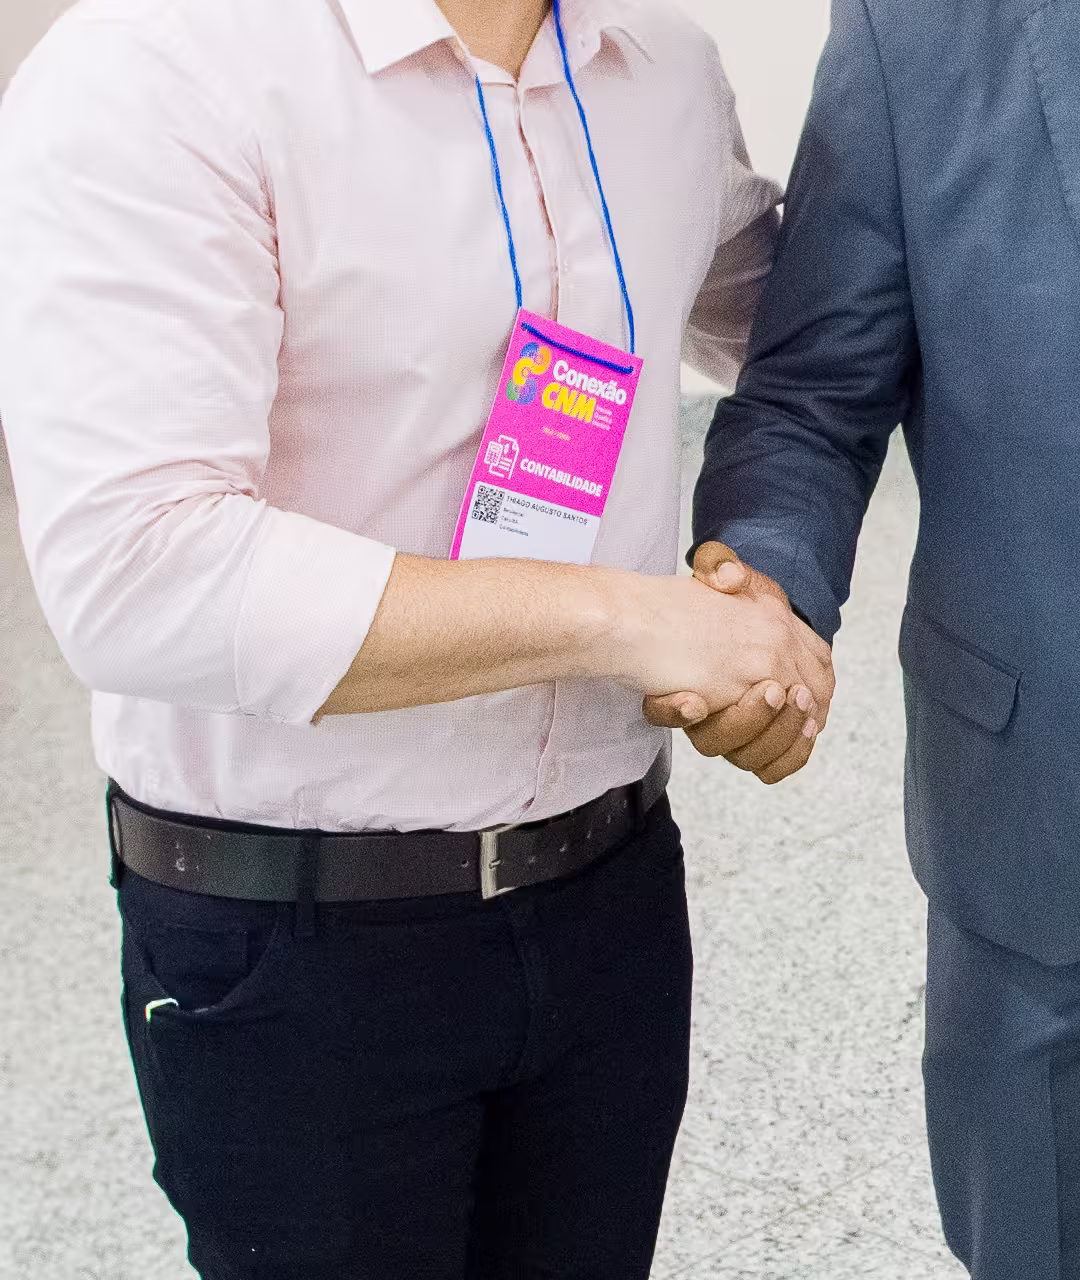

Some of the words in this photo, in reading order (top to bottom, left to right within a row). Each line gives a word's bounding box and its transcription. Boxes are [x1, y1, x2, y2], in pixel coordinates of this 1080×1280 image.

[553, 360, 627, 405] Conexão
[542, 382, 596, 424] CNM
[520, 458, 603, 497] CONTABILIDADE
[507, 495, 531, 508] THIAGO
[531, 504, 562, 518] AUGUSTO
[563, 513, 588, 525] SANTOS
